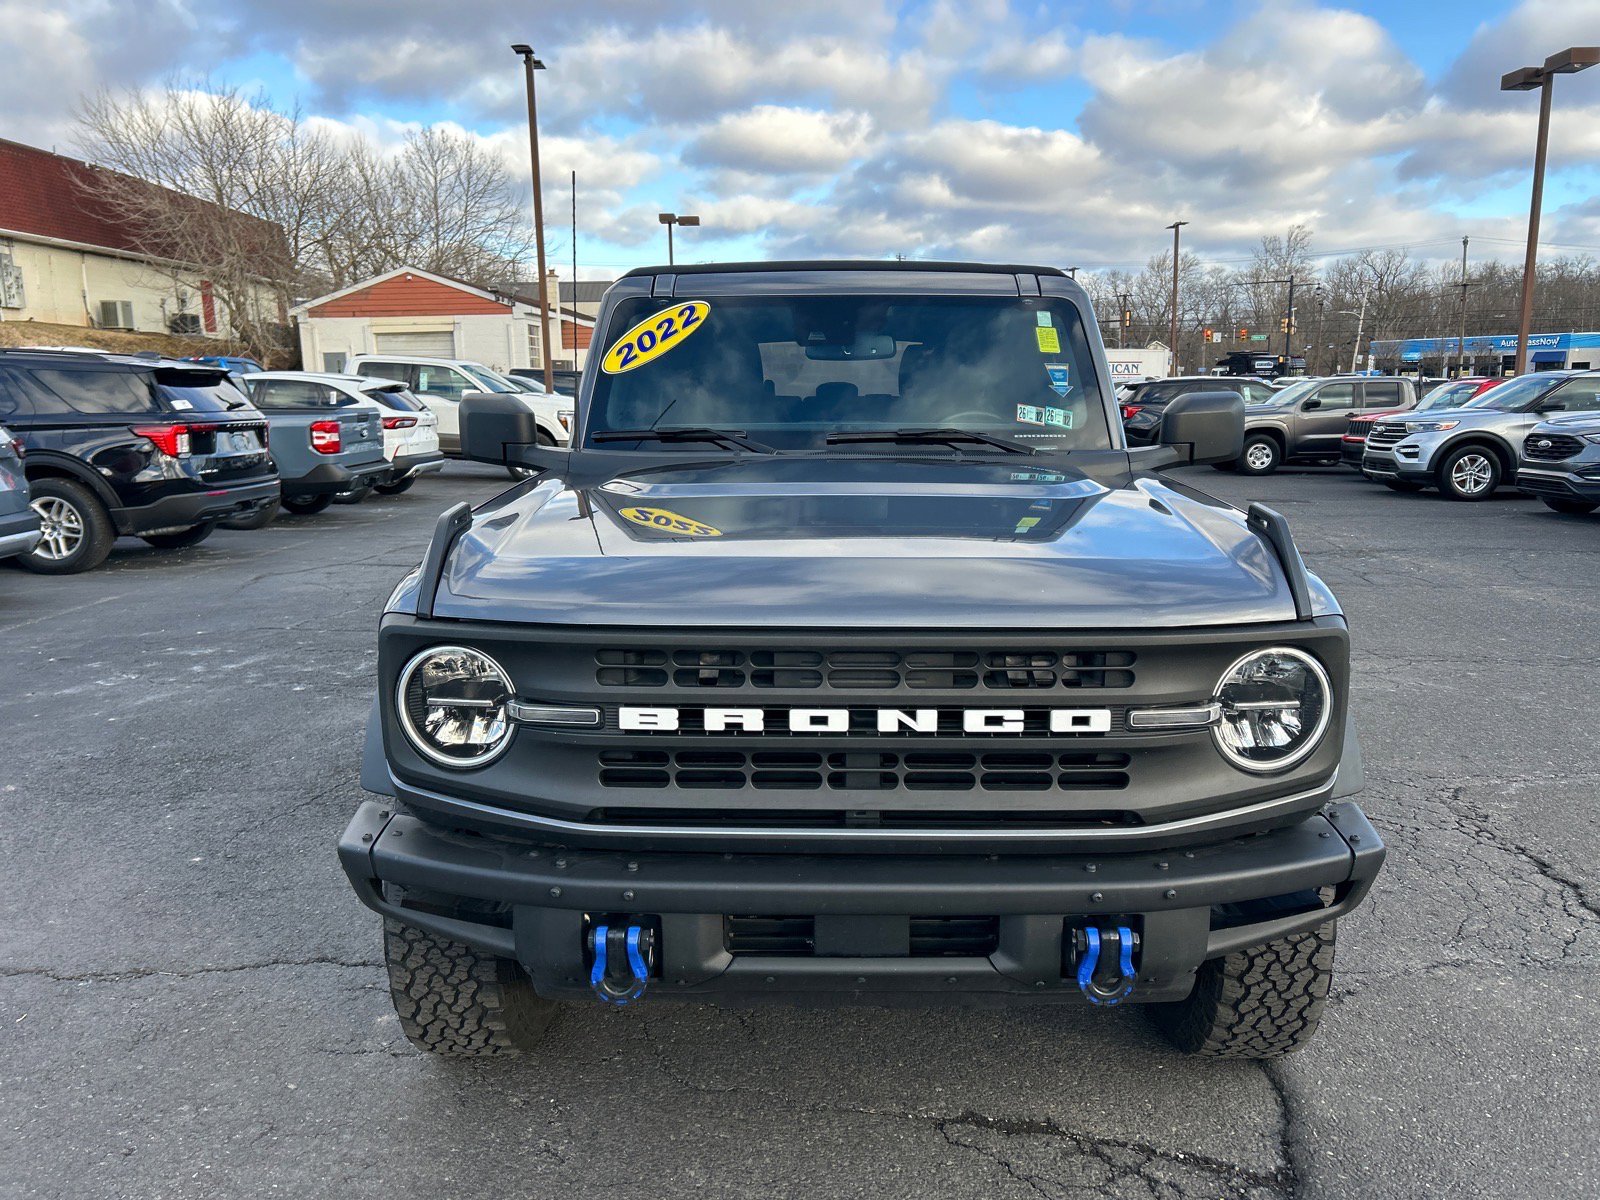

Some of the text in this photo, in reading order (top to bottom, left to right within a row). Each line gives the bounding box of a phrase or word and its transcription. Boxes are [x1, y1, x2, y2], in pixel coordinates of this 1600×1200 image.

[616, 304, 701, 369] 2022
[1108, 363, 1139, 374] ICAN
[1018, 406, 1044, 422] 26 12
[1046, 409, 1071, 427] 26 12
[618, 706, 1112, 733] BRONCO
